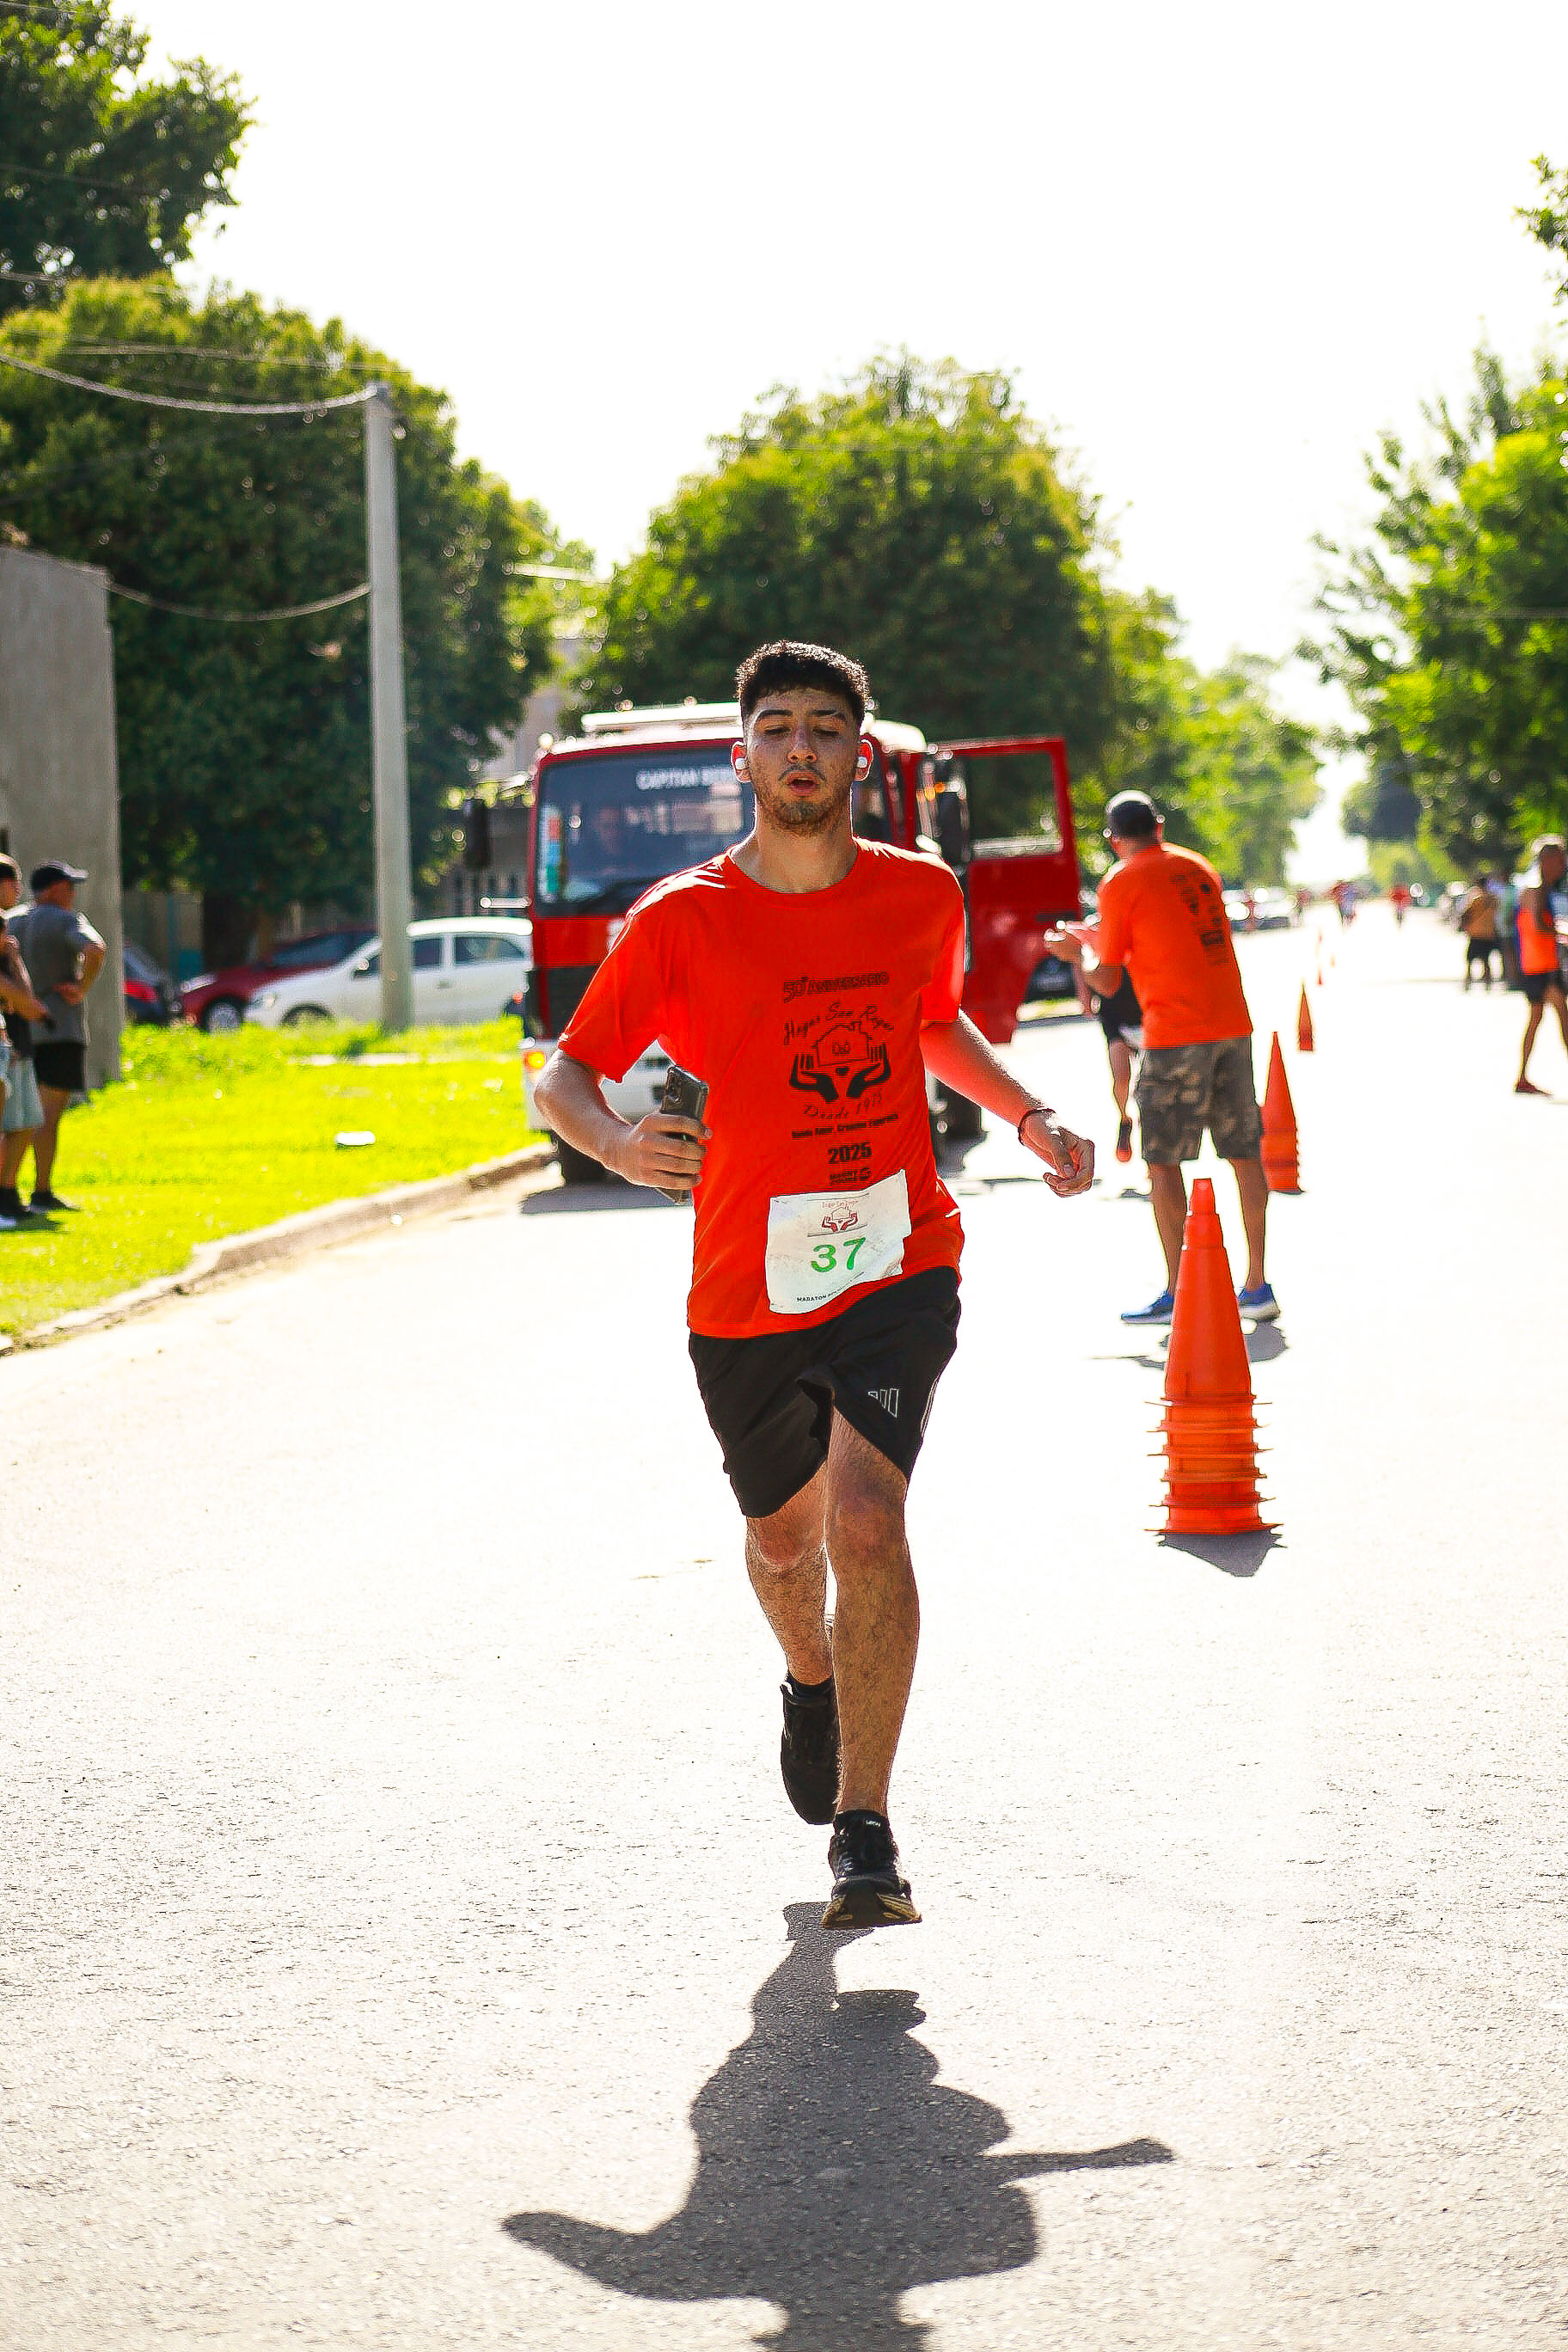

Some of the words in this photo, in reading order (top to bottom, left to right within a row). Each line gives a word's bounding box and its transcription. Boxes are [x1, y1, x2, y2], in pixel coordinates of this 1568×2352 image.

[807, 971, 889, 995] ANIVERSARIO
[803, 1105, 849, 1120] Desde
[828, 1141, 872, 1165] 2025
[811, 1237, 867, 1273] 37
